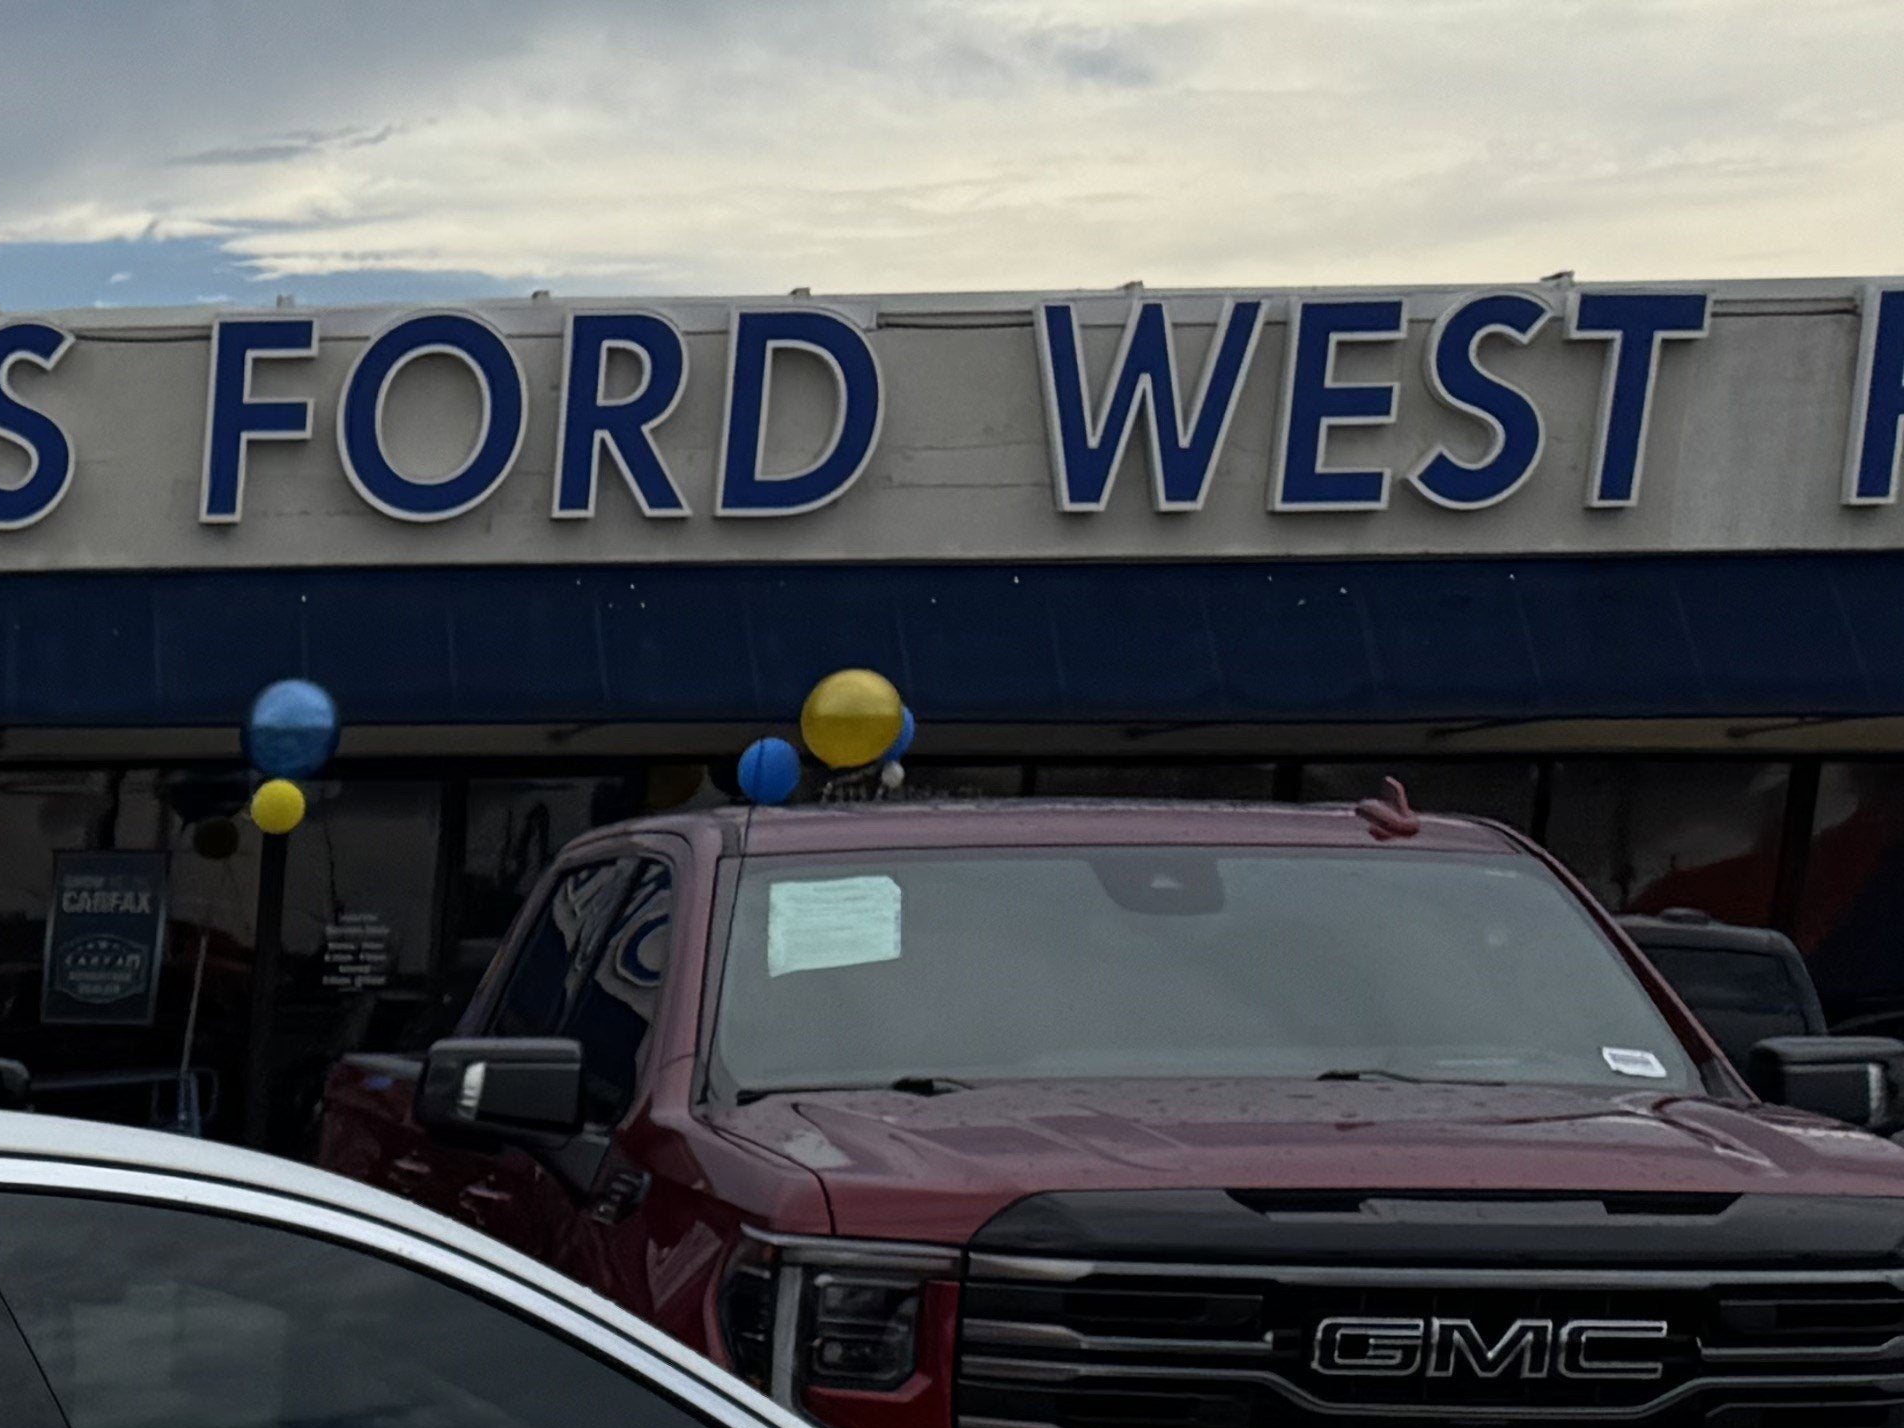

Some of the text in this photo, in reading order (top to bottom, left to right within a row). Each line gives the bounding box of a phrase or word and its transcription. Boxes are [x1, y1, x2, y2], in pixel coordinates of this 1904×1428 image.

[203, 311, 882, 518] FORD
[1040, 293, 1709, 506] WEST
[61, 889, 151, 914] CARFAX
[1309, 1315, 1669, 1379] GMC
